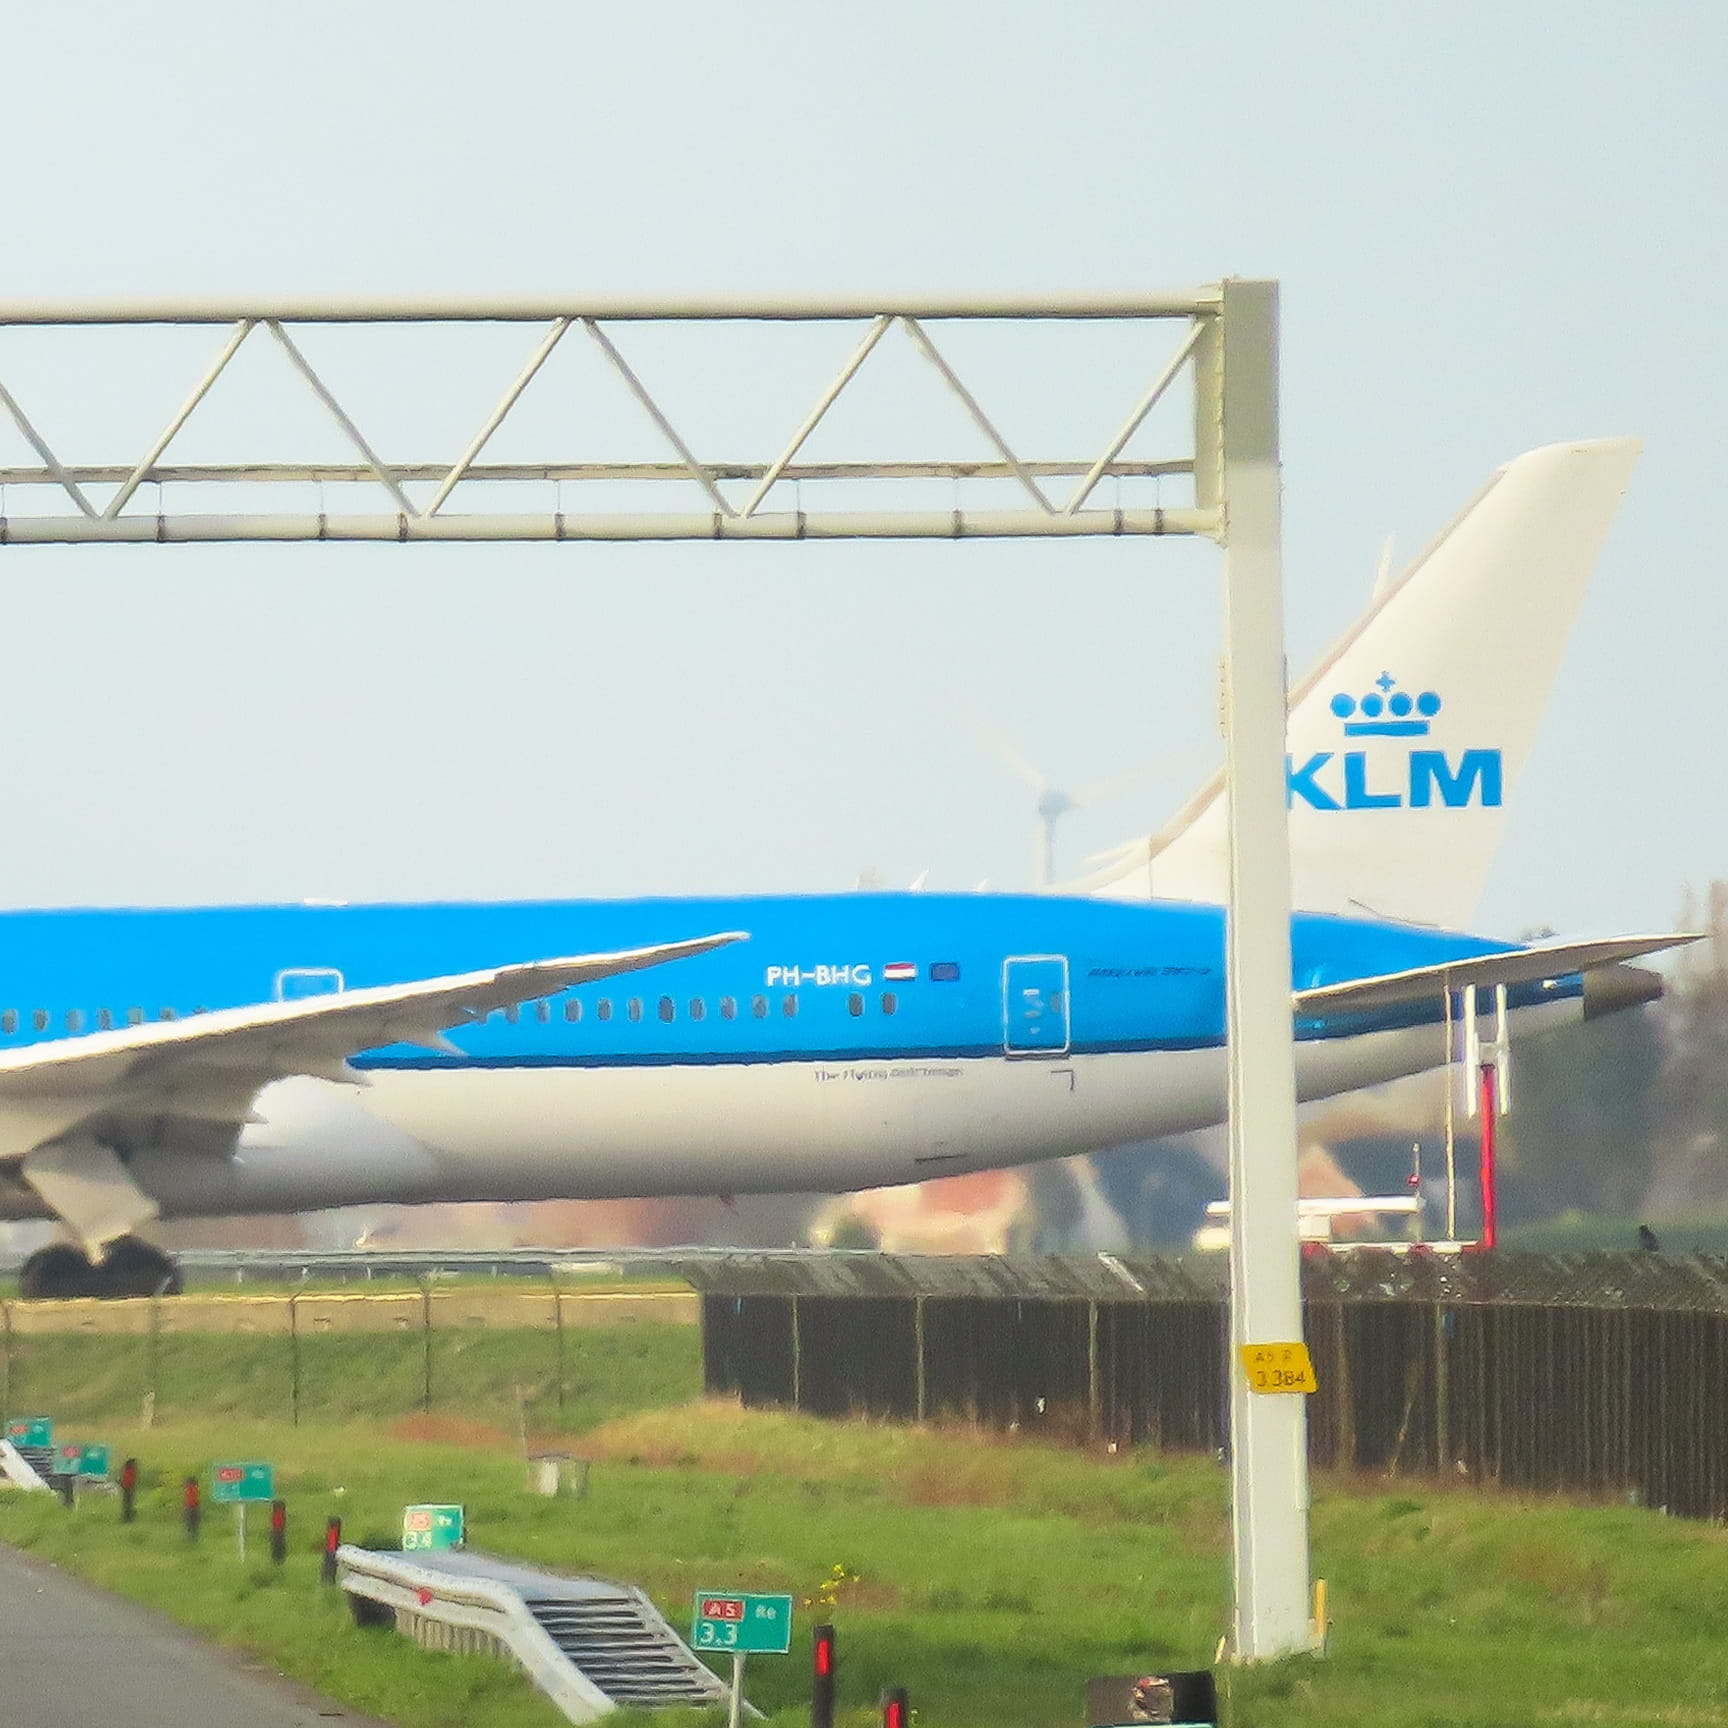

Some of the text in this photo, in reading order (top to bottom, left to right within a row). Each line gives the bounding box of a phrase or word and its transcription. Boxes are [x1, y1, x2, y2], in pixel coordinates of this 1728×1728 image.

[1284, 748, 1503, 811] KLM
[766, 963, 872, 987] PH-BHG
[708, 1602, 736, 1617] A5
